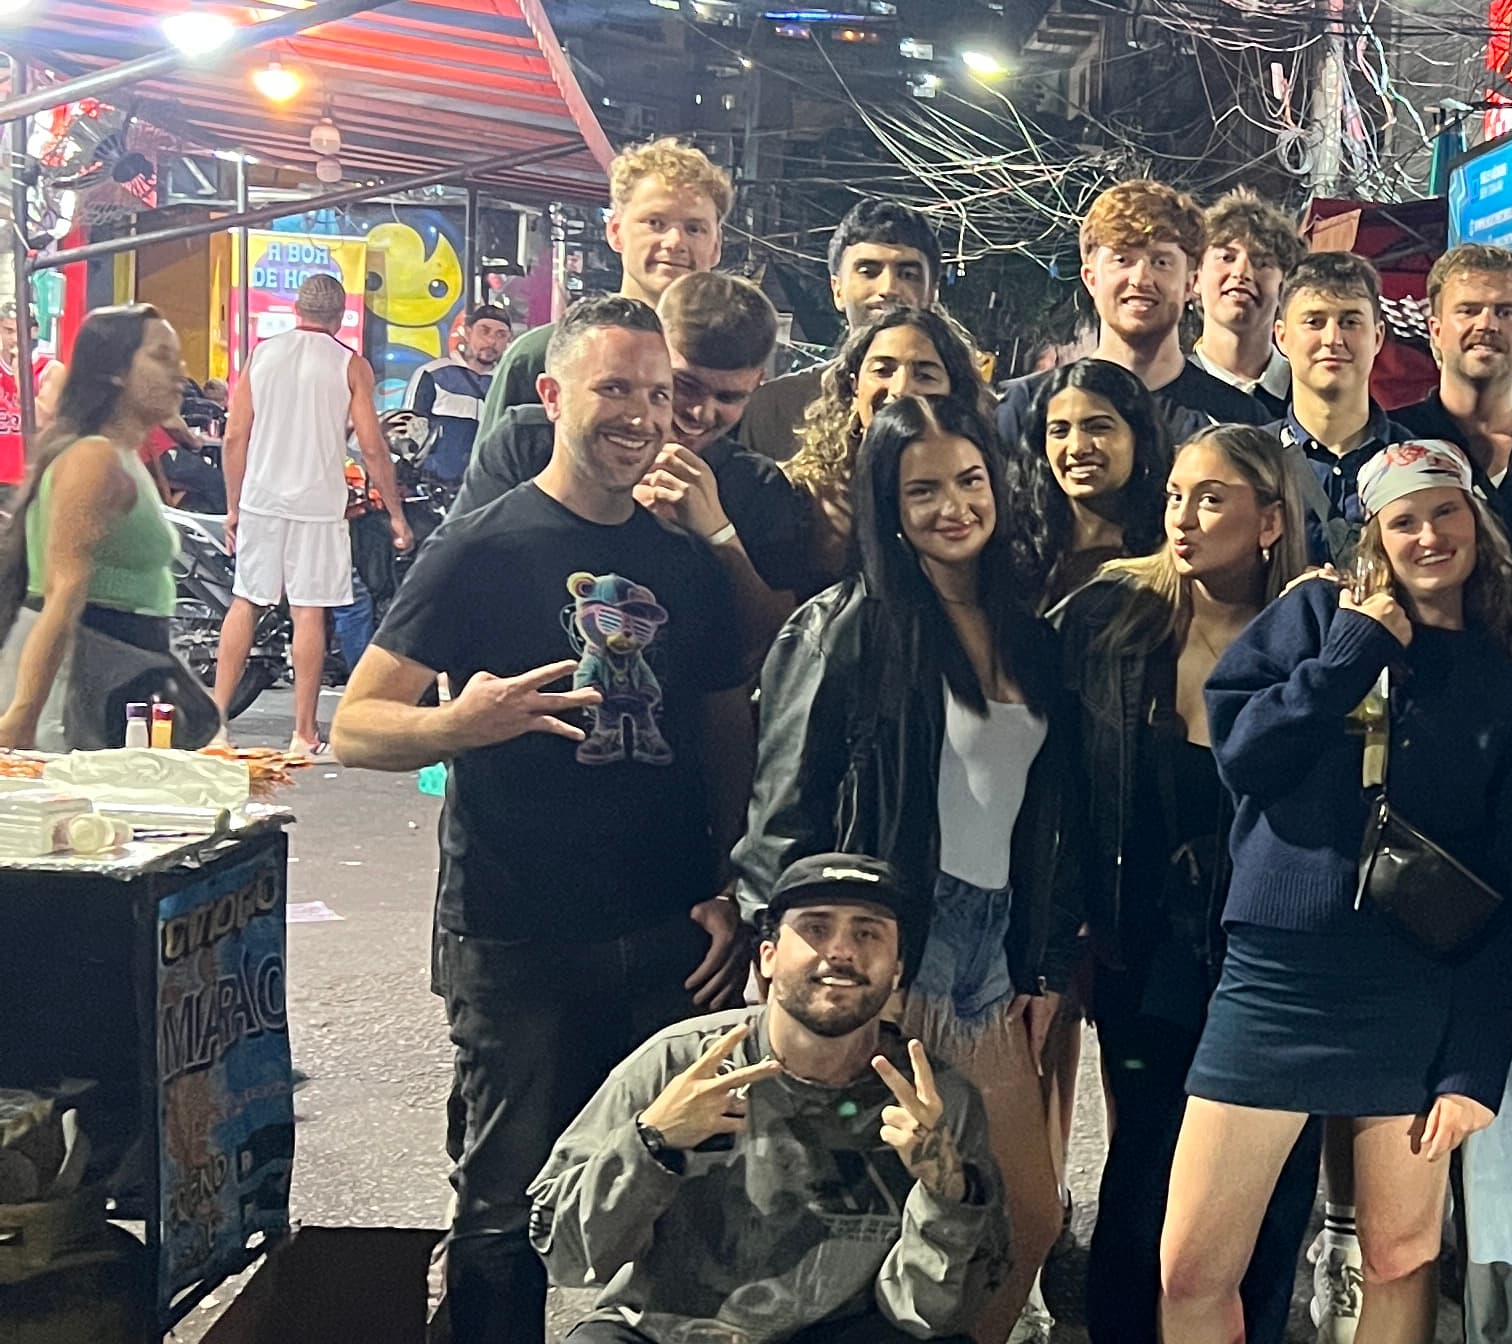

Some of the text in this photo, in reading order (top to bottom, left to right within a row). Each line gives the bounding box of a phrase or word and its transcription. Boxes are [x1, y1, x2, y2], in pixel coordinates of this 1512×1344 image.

[267, 242, 330, 264] A BOA
[253, 267, 278, 288] DE
